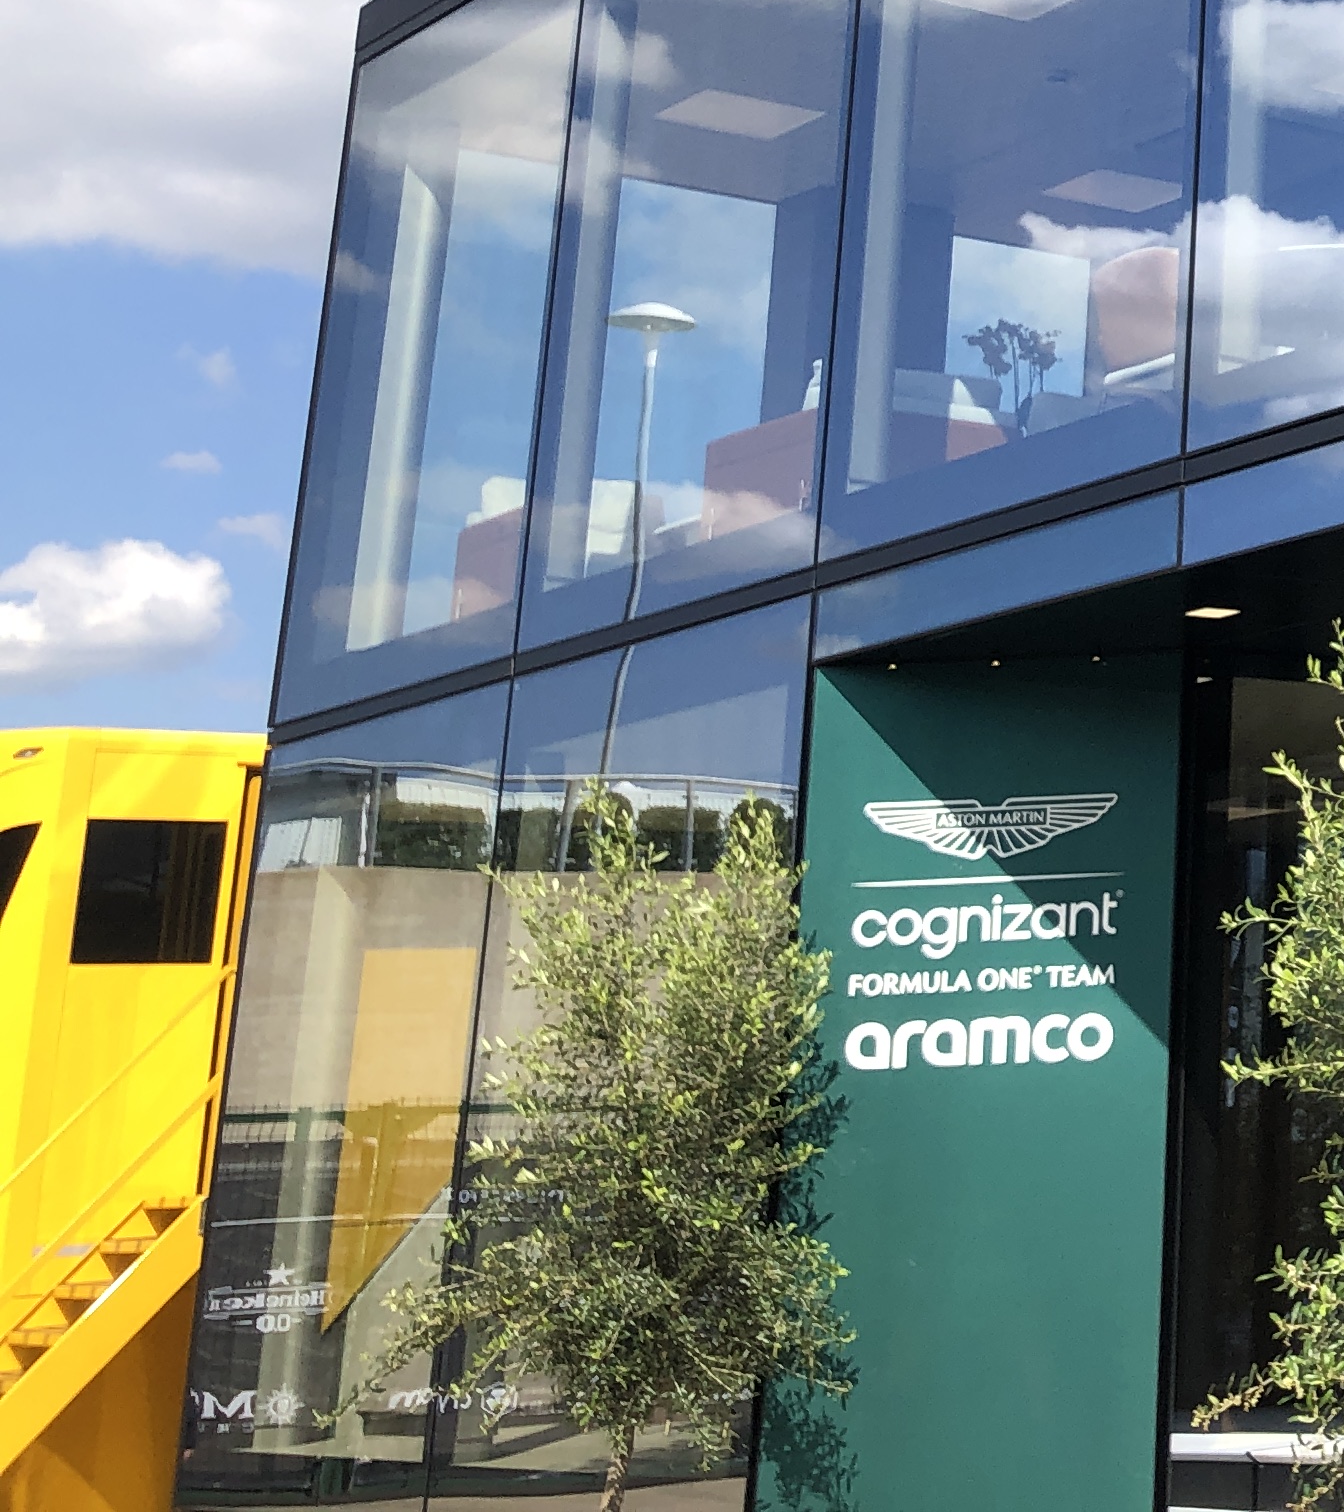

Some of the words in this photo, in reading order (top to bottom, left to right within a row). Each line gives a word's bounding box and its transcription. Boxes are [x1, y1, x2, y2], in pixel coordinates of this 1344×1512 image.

[936, 811, 986, 828] ASTON
[988, 810, 1045, 826] MARTIN
[851, 891, 1119, 959] cognizant
[847, 969, 972, 997] FORMULA
[1045, 963, 1116, 988] TEAM
[844, 1012, 1114, 1070] aramco
